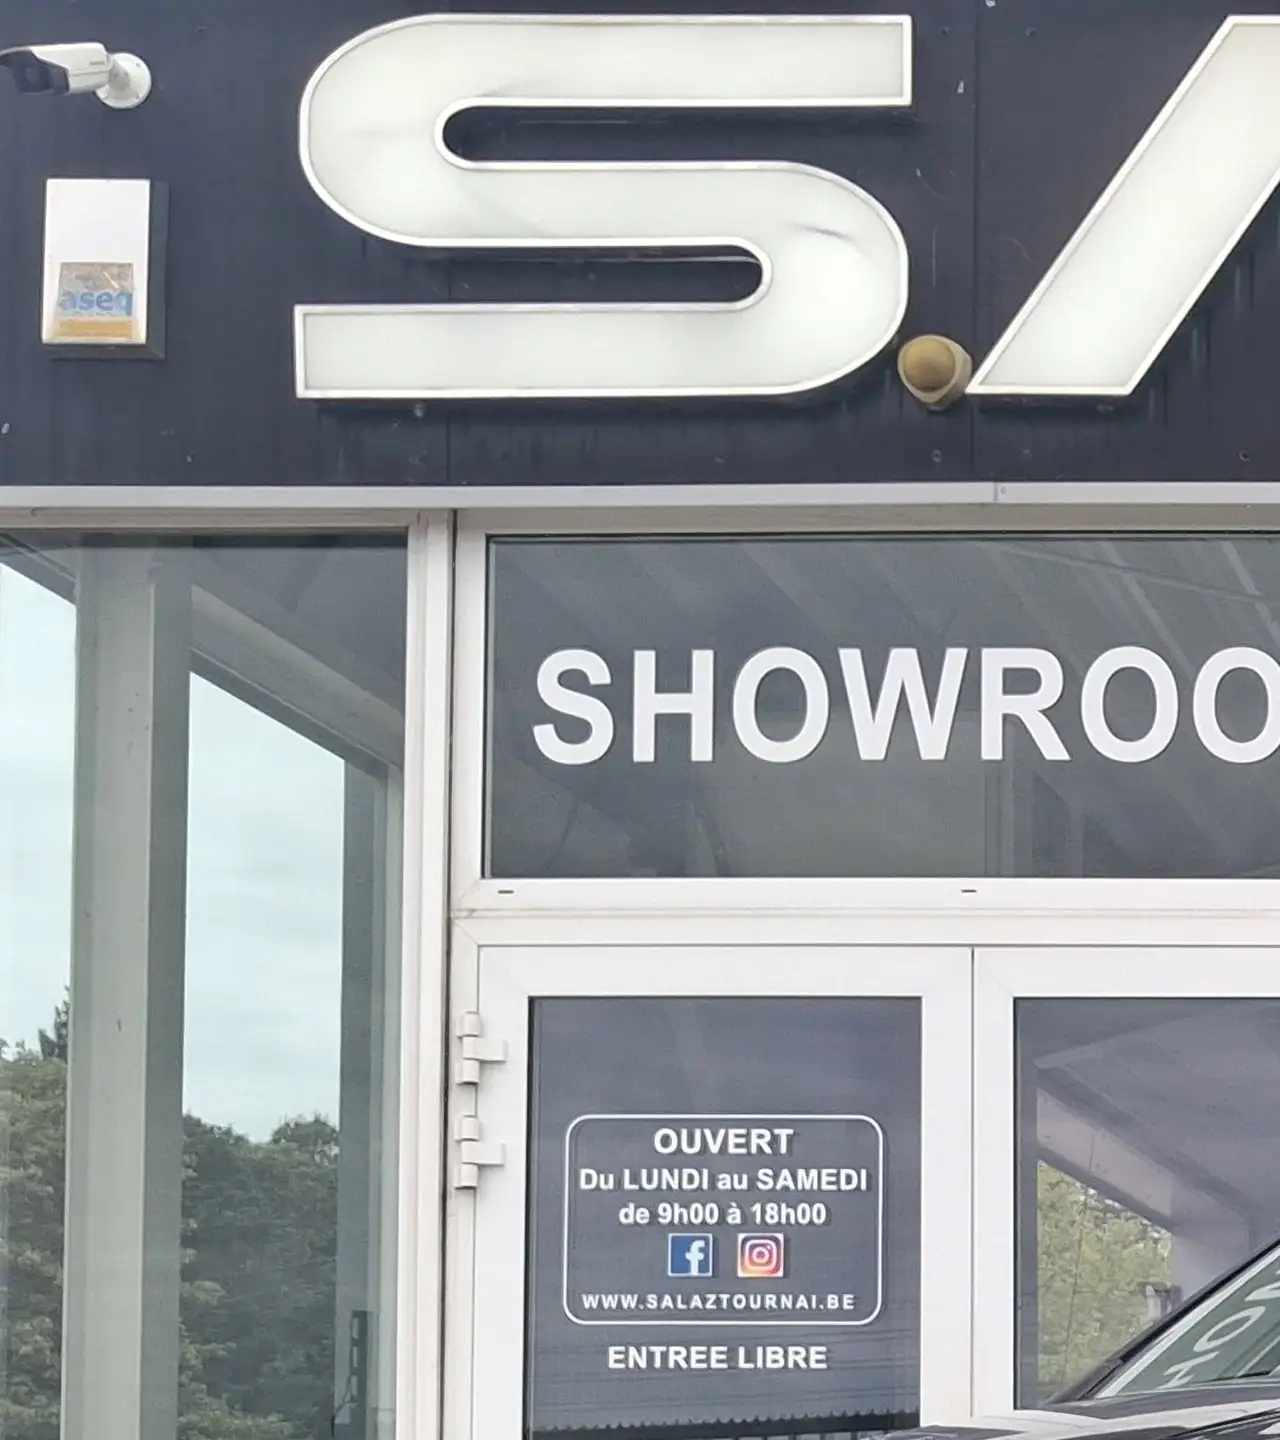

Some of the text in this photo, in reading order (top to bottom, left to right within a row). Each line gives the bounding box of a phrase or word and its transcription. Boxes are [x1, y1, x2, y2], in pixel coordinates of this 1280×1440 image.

[653, 1127, 795, 1155] OUVERT
[579, 1167, 867, 1192] Du LUNDI au SAMEDI
[618, 1202, 827, 1225] de 9h00 à 18h00
[581, 1293, 855, 1311] WWW.SALAZTOURNAI.BE
[608, 1345, 828, 1369] ENTREE LIBRE
